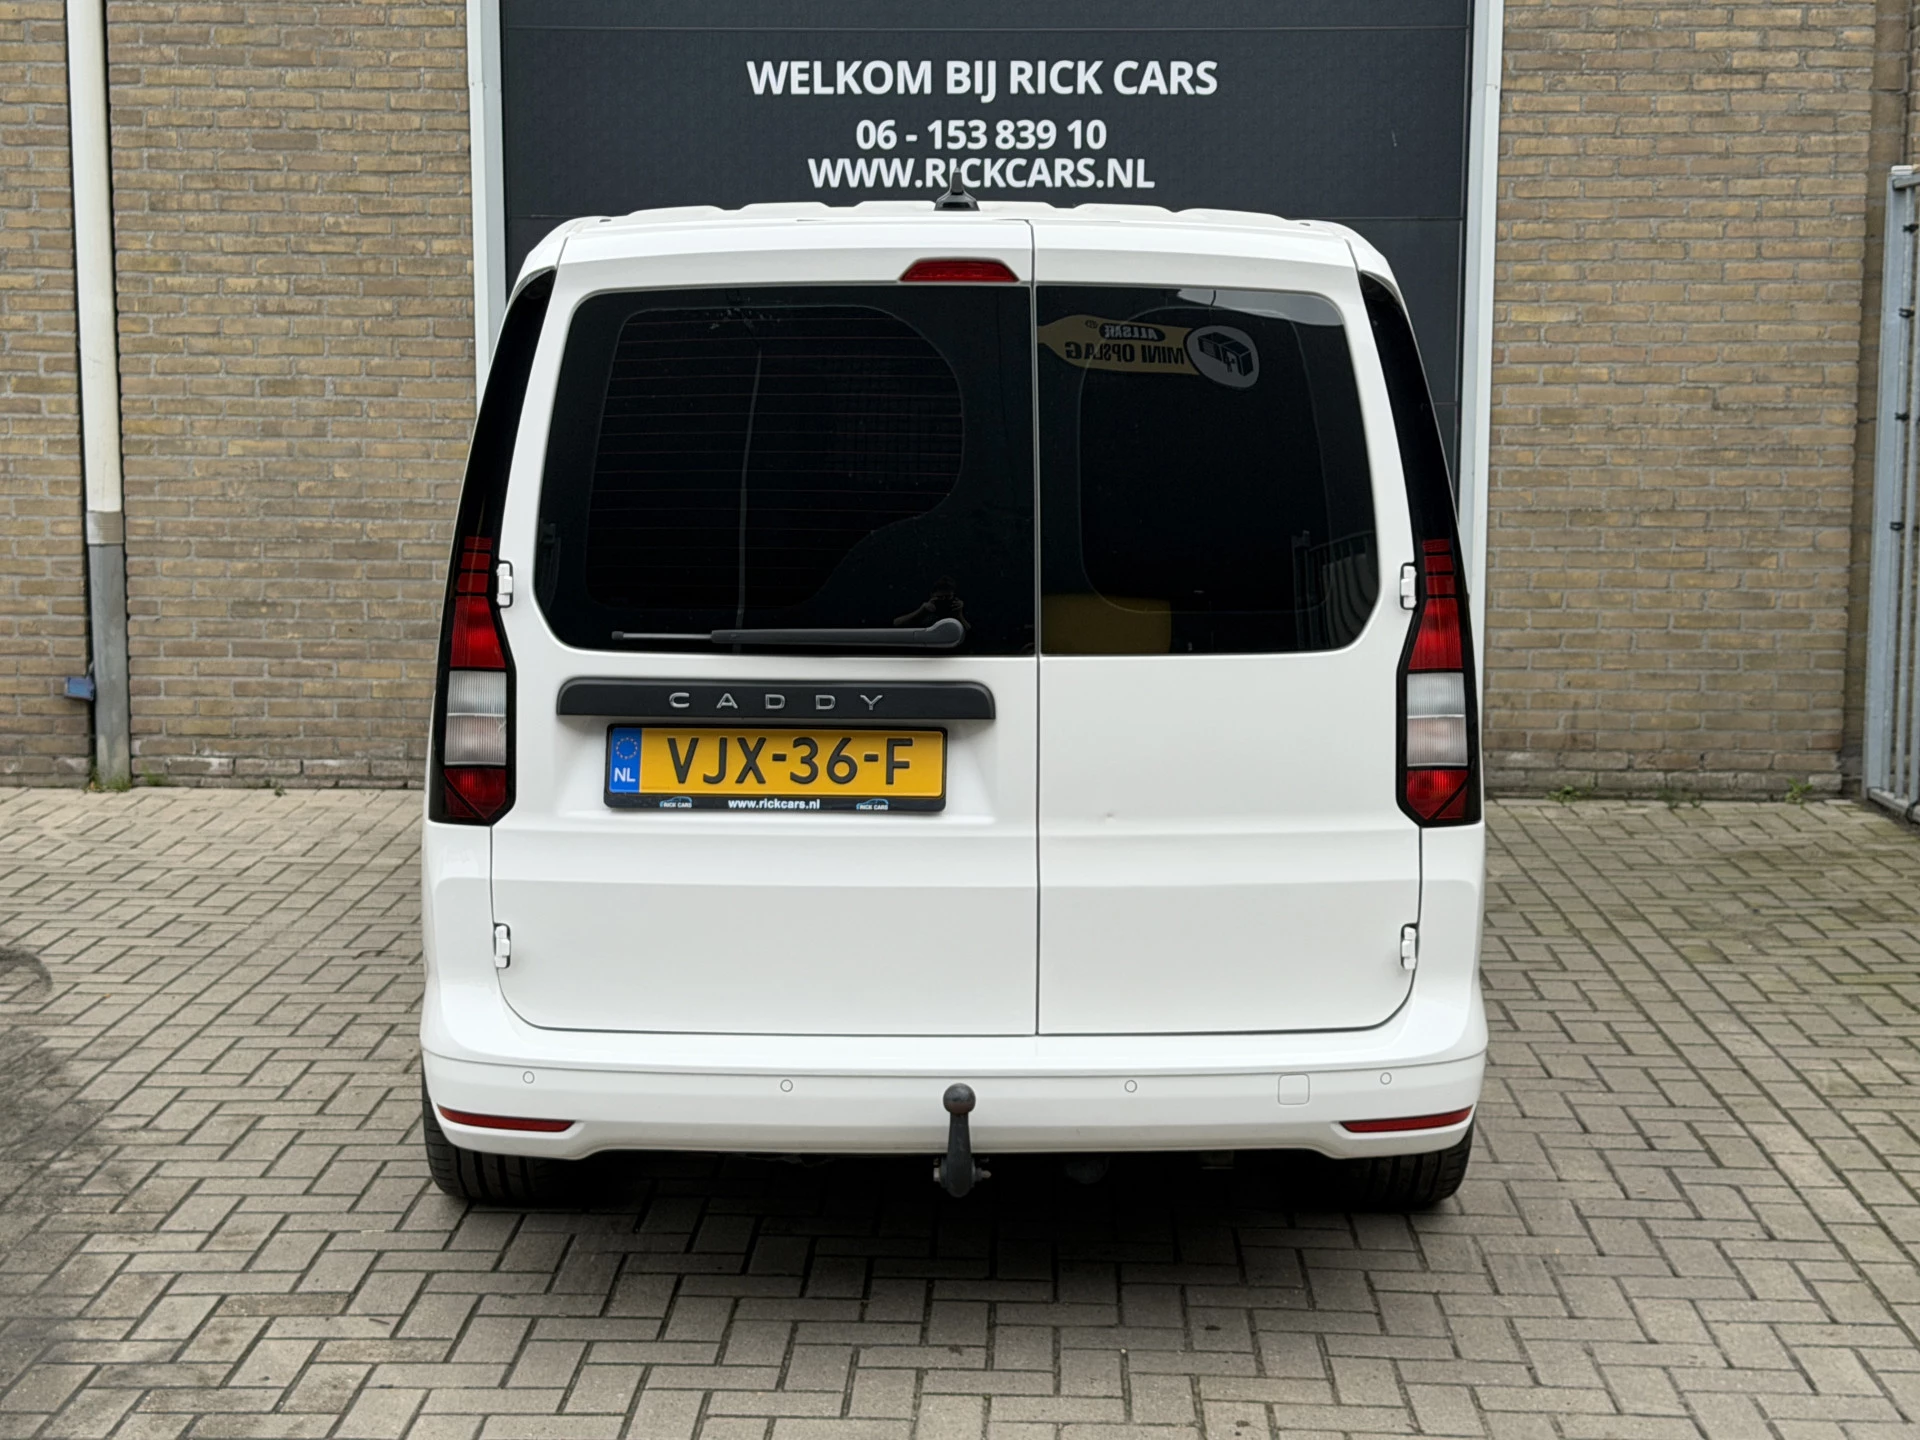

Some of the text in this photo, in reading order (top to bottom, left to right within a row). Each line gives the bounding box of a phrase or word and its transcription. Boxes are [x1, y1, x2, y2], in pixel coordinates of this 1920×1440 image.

[746, 60, 1218, 103] WELKOM BIJ RICK CARS
[856, 119, 897, 150] 06
[927, 119, 987, 150] 153
[995, 119, 1057, 150] 839
[1067, 119, 1107, 150] 10
[808, 157, 1155, 188] WWW.RICKCARS.NL
[669, 692, 883, 711] CADDY
[614, 767, 636, 783] NL
[667, 736, 913, 786] VJX-36-F
[728, 798, 820, 809] www.rickcars.nl
